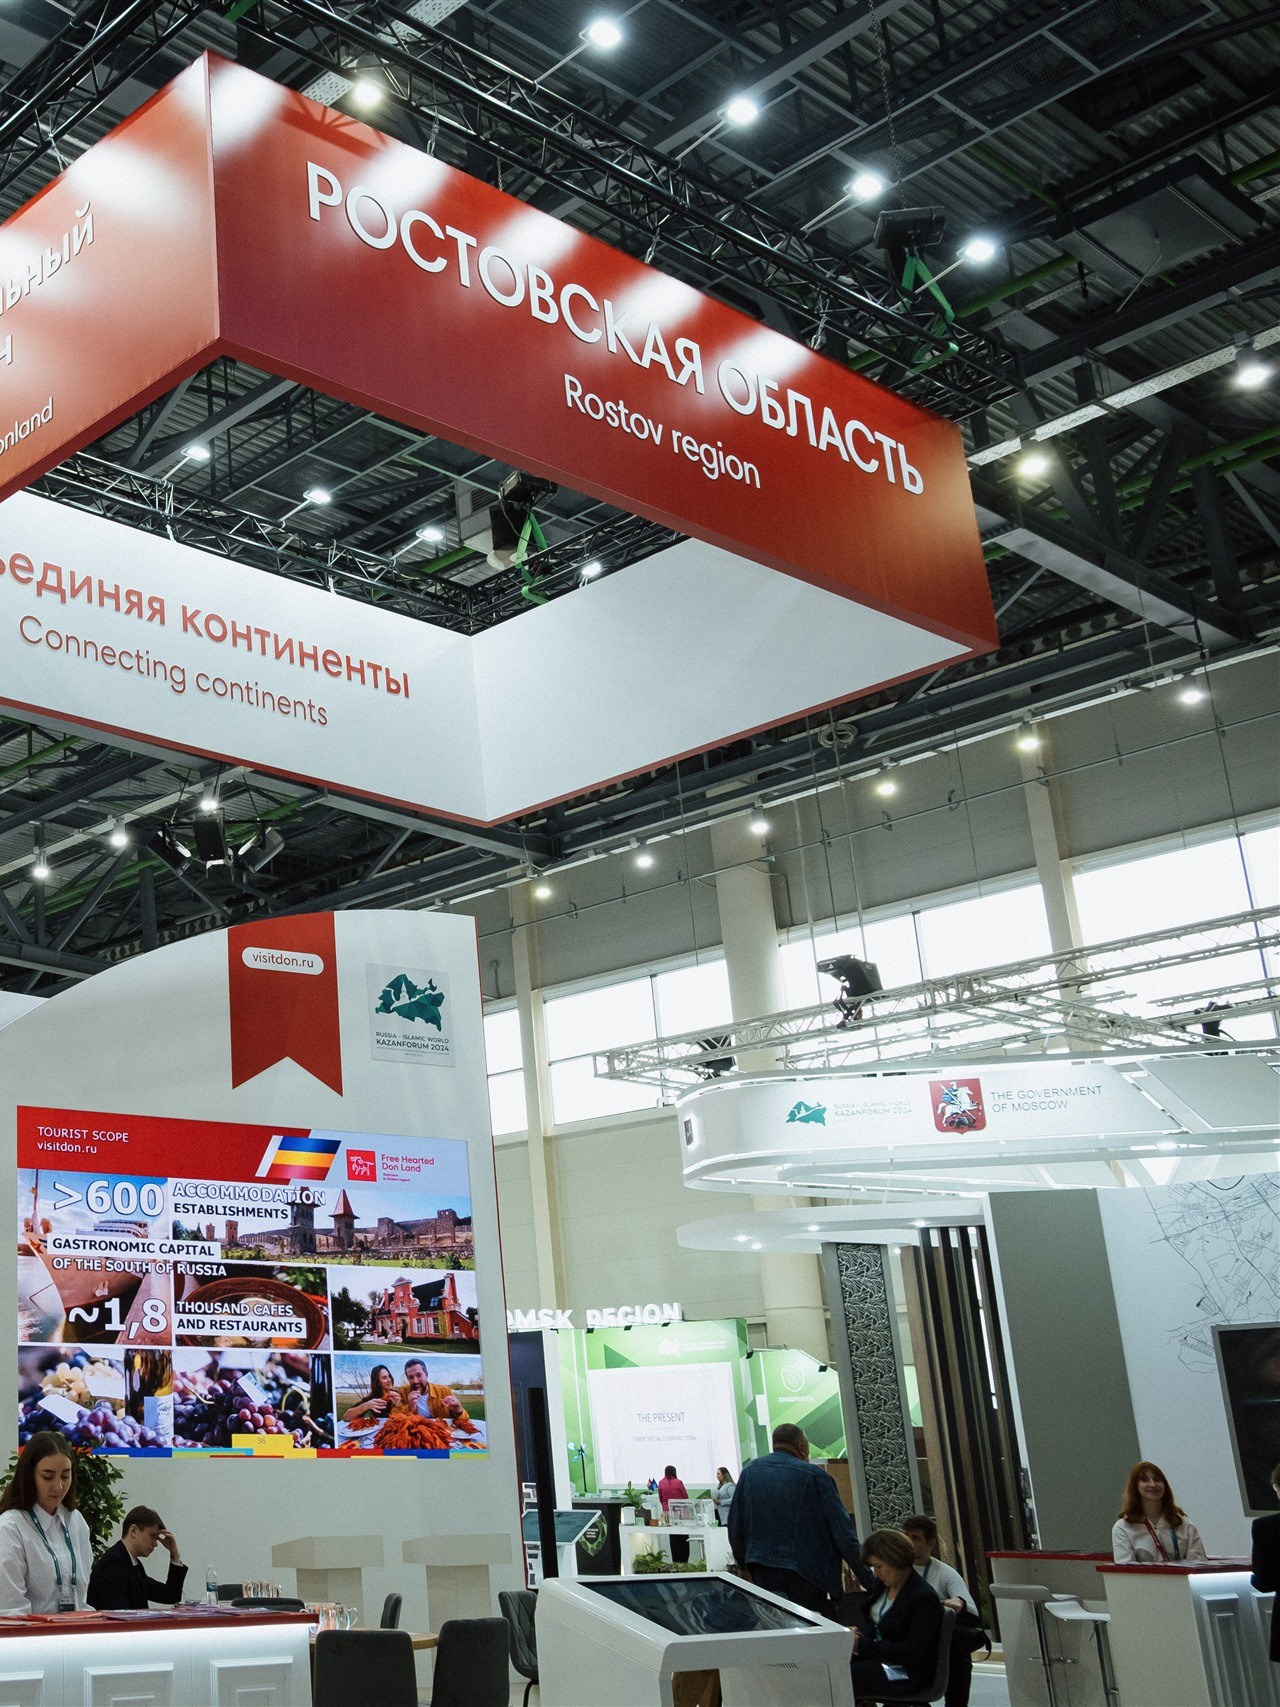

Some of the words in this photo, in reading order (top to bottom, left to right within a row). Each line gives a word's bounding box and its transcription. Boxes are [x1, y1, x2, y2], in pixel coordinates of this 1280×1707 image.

[306, 161, 705, 395] РОСТОВСКАЯ
[717, 358, 924, 496] ОБЛАСТЬ
[564, 373, 664, 446] Rostov
[671, 425, 761, 489] region
[20, 615, 186, 694] Connecting
[196, 670, 329, 726] continents
[252, 951, 315, 968] visitdon.ru
[376, 1038, 429, 1049] KAZANFORUM
[990, 1090, 1014, 1102] THE
[1017, 1085, 1102, 1100] GOVERNMENT
[992, 1102, 1010, 1113] OF
[1012, 1100, 1068, 1112] MOSCOW
[37, 1126, 89, 1140] TOURIST
[92, 1130, 129, 1143] SCOPE
[37, 1141, 97, 1154] visitdon.ru
[381, 1154, 399, 1162] Free
[401, 1156, 435, 1165] Hearted
[382, 1163, 398, 1171] Don
[401, 1164, 421, 1172] Land
[173, 1182, 326, 1206] ACCOMMODATION
[174, 1202, 289, 1219] ESTABLISHMENTS
[52, 1238, 156, 1254] GASTRONOMIC
[159, 1243, 215, 1257] CAPITAL
[52, 1258, 72, 1270] OF
[74, 1259, 102, 1272] THE
[105, 1260, 152, 1274] SOUTH
[155, 1262, 174, 1275] OF
[177, 1263, 227, 1277] RUSSIA
[177, 1301, 250, 1316] THOUSAND
[253, 1303, 293, 1316] CAFES
[586, 1302, 682, 1327] REGION
[177, 1318, 206, 1330] AND
[210, 1319, 303, 1333] RESTAURANTS
[638, 1413, 652, 1422] THE
[654, 1412, 684, 1422] PRESENT
[257, 1437, 267, 1445] 36
